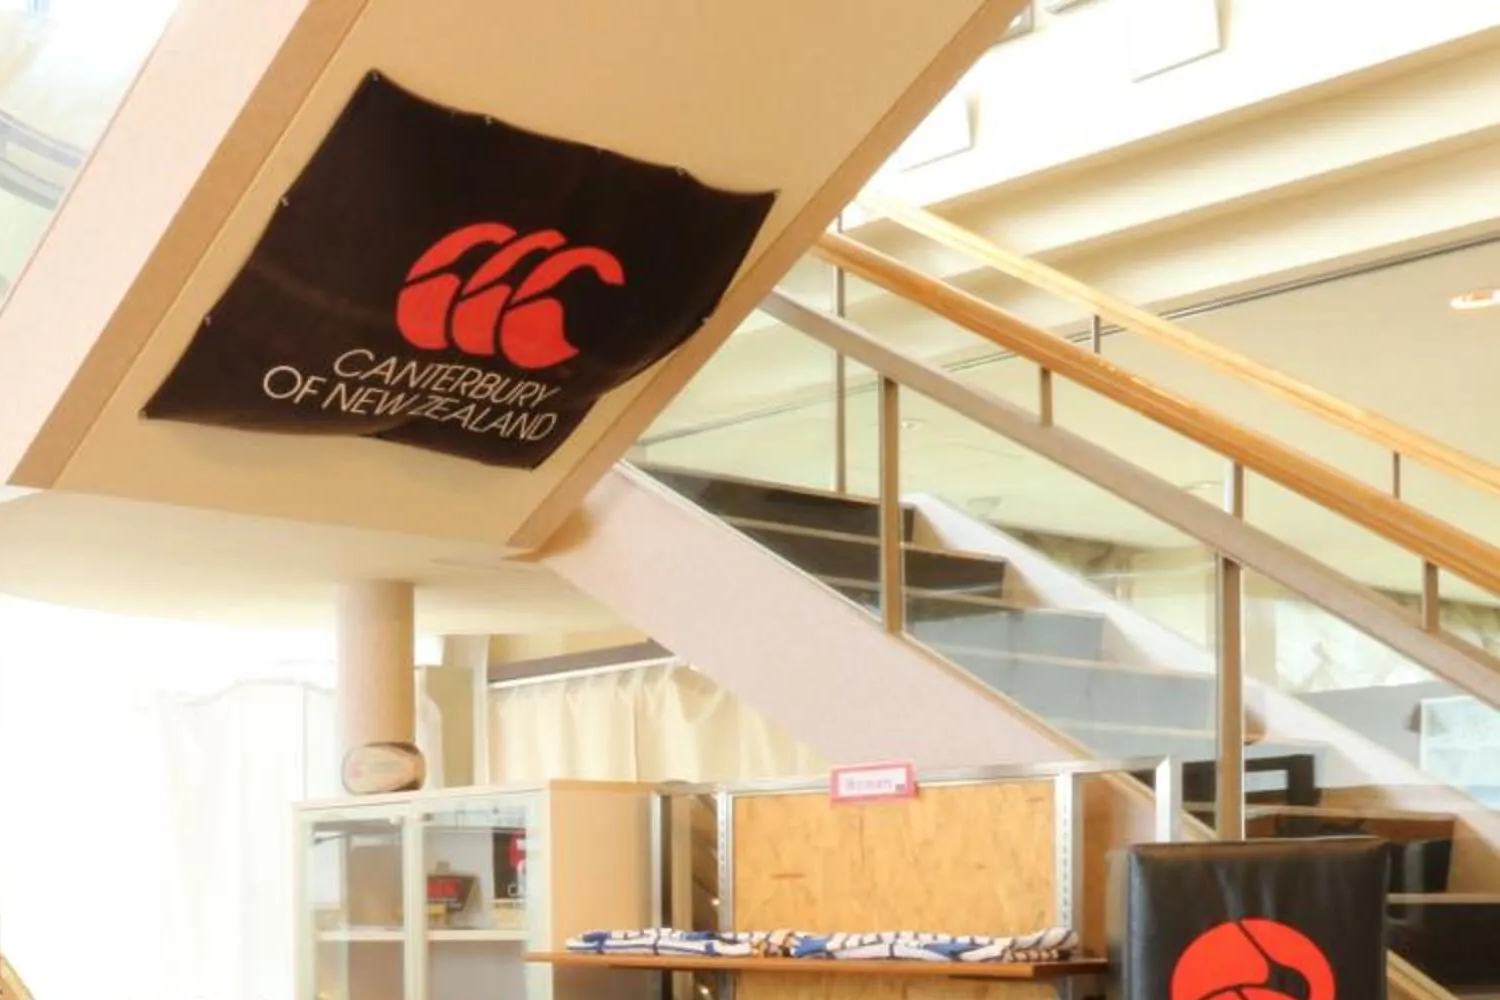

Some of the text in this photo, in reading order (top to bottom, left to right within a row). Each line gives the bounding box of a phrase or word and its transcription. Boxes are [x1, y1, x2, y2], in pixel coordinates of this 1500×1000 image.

[263, 365, 558, 441] OF NEW ZEALAND
[334, 349, 561, 408] CANTERBURY
